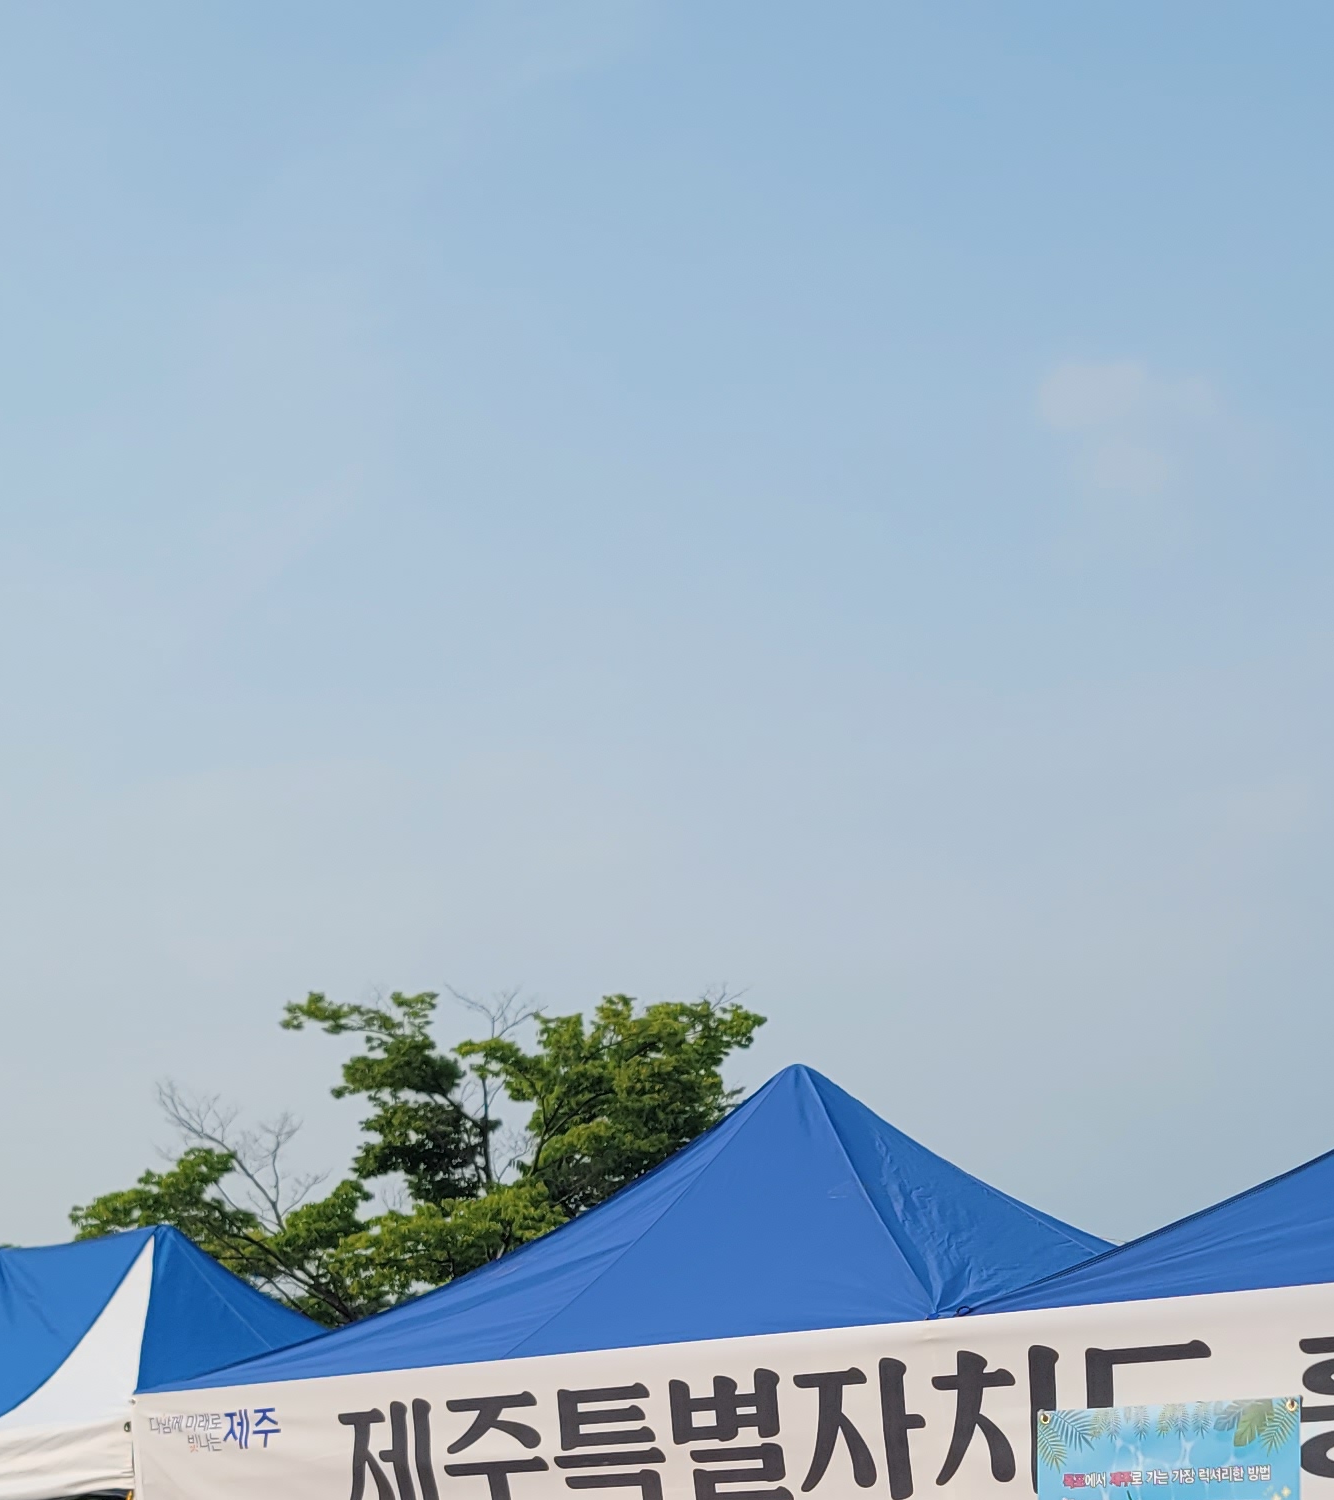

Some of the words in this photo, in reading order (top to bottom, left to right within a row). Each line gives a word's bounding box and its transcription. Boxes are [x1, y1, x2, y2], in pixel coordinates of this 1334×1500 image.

[185, 1413, 222, 1432] 미래로
[223, 1407, 281, 1449] 제주
[187, 1432, 222, 1453] 빛나는
[1109, 1470, 1143, 1487] 제주로
[1146, 1469, 1168, 1485] 가는
[1171, 1468, 1196, 1484] 가장
[1198, 1466, 1244, 1483] 럭셔리한
[1247, 1464, 1271, 1481] 방법
